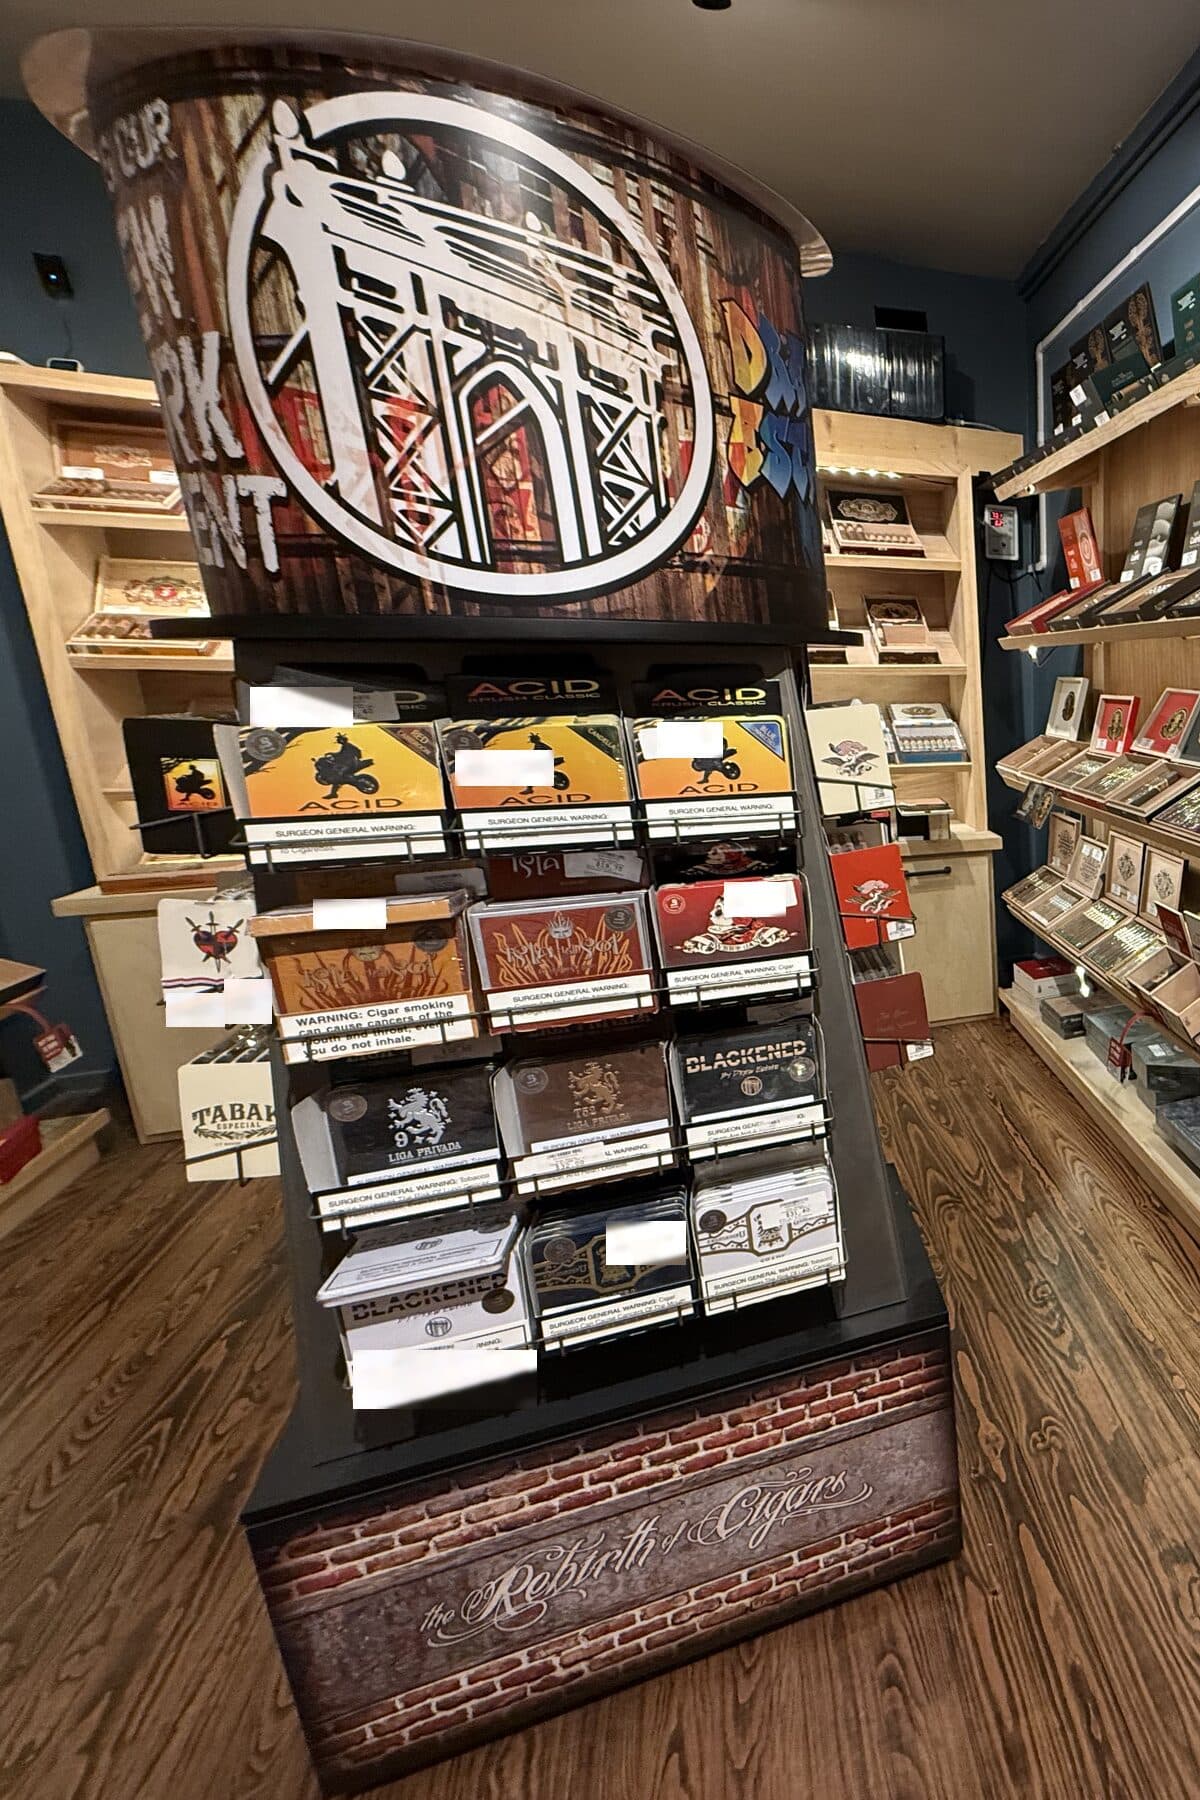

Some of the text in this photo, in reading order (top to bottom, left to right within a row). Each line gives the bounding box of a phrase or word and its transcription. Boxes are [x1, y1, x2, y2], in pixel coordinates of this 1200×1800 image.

[467, 679, 600, 698] ACID
[651, 687, 767, 701] ACID
[532, 692, 600, 701] CLASSIC
[679, 782, 759, 796] ACID
[297, 797, 403, 812] ACID
[499, 793, 592, 806] ACID
[668, 806, 704, 816] SURGEON
[704, 805, 738, 814] GENERAL
[488, 817, 530, 826] SURGEON
[531, 815, 568, 824] GENERAL
[275, 823, 417, 838] SURGEON GENERAL WARNING:
[674, 974, 710, 984] SURGEON
[711, 970, 742, 979] GENERAL
[513, 993, 553, 1003] SURGEON
[553, 989, 591, 998] GENERAL
[296, 1000, 453, 1027] WARNING: Cigar smoking
[299, 1010, 453, 1038] can cause cancers of the
[304, 1034, 416, 1058] you do not inhale.
[686, 1039, 807, 1074] BLACKENED
[573, 1104, 597, 1118] T52
[216, 1121, 261, 1130] ESPECIAL
[707, 1126, 742, 1137] SURGEON
[394, 1131, 409, 1148] 9
[388, 1141, 463, 1164] LIGA PRIVADA
[328, 1192, 373, 1207] SURGEON
[374, 1186, 415, 1200] GENERAL
[460, 1173, 491, 1182] Tobacco
[748, 1273, 777, 1286] GENERAL
[352, 1273, 508, 1321] BLACKENED
[549, 1316, 587, 1330] SURGEON
[587, 1310, 621, 1323] GENERAL
[420, 1467, 848, 1634] the Rebirth of Cigars
